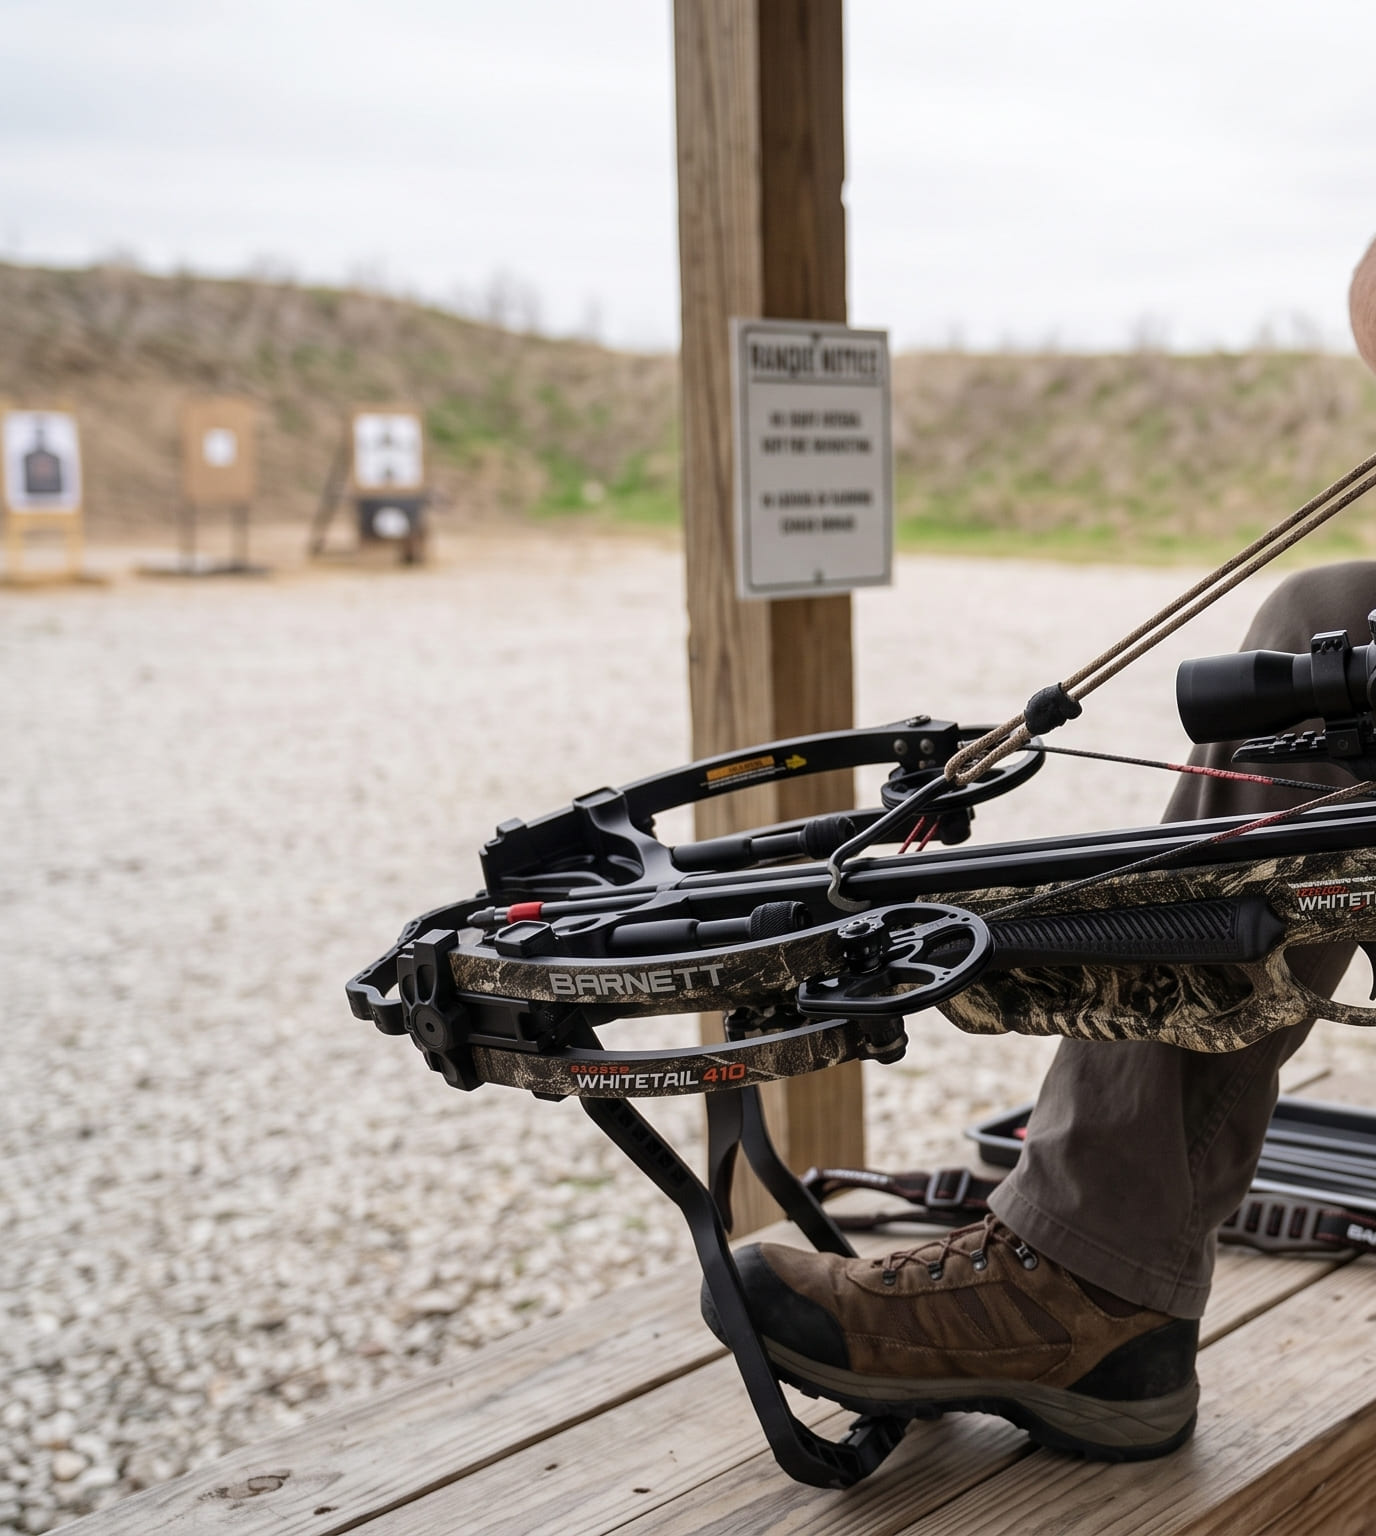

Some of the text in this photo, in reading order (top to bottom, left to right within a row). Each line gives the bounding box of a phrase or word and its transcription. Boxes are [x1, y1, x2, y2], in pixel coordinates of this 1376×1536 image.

[549, 963, 724, 995] BARNETT
[577, 1063, 746, 1089] WHITETAIL 410
